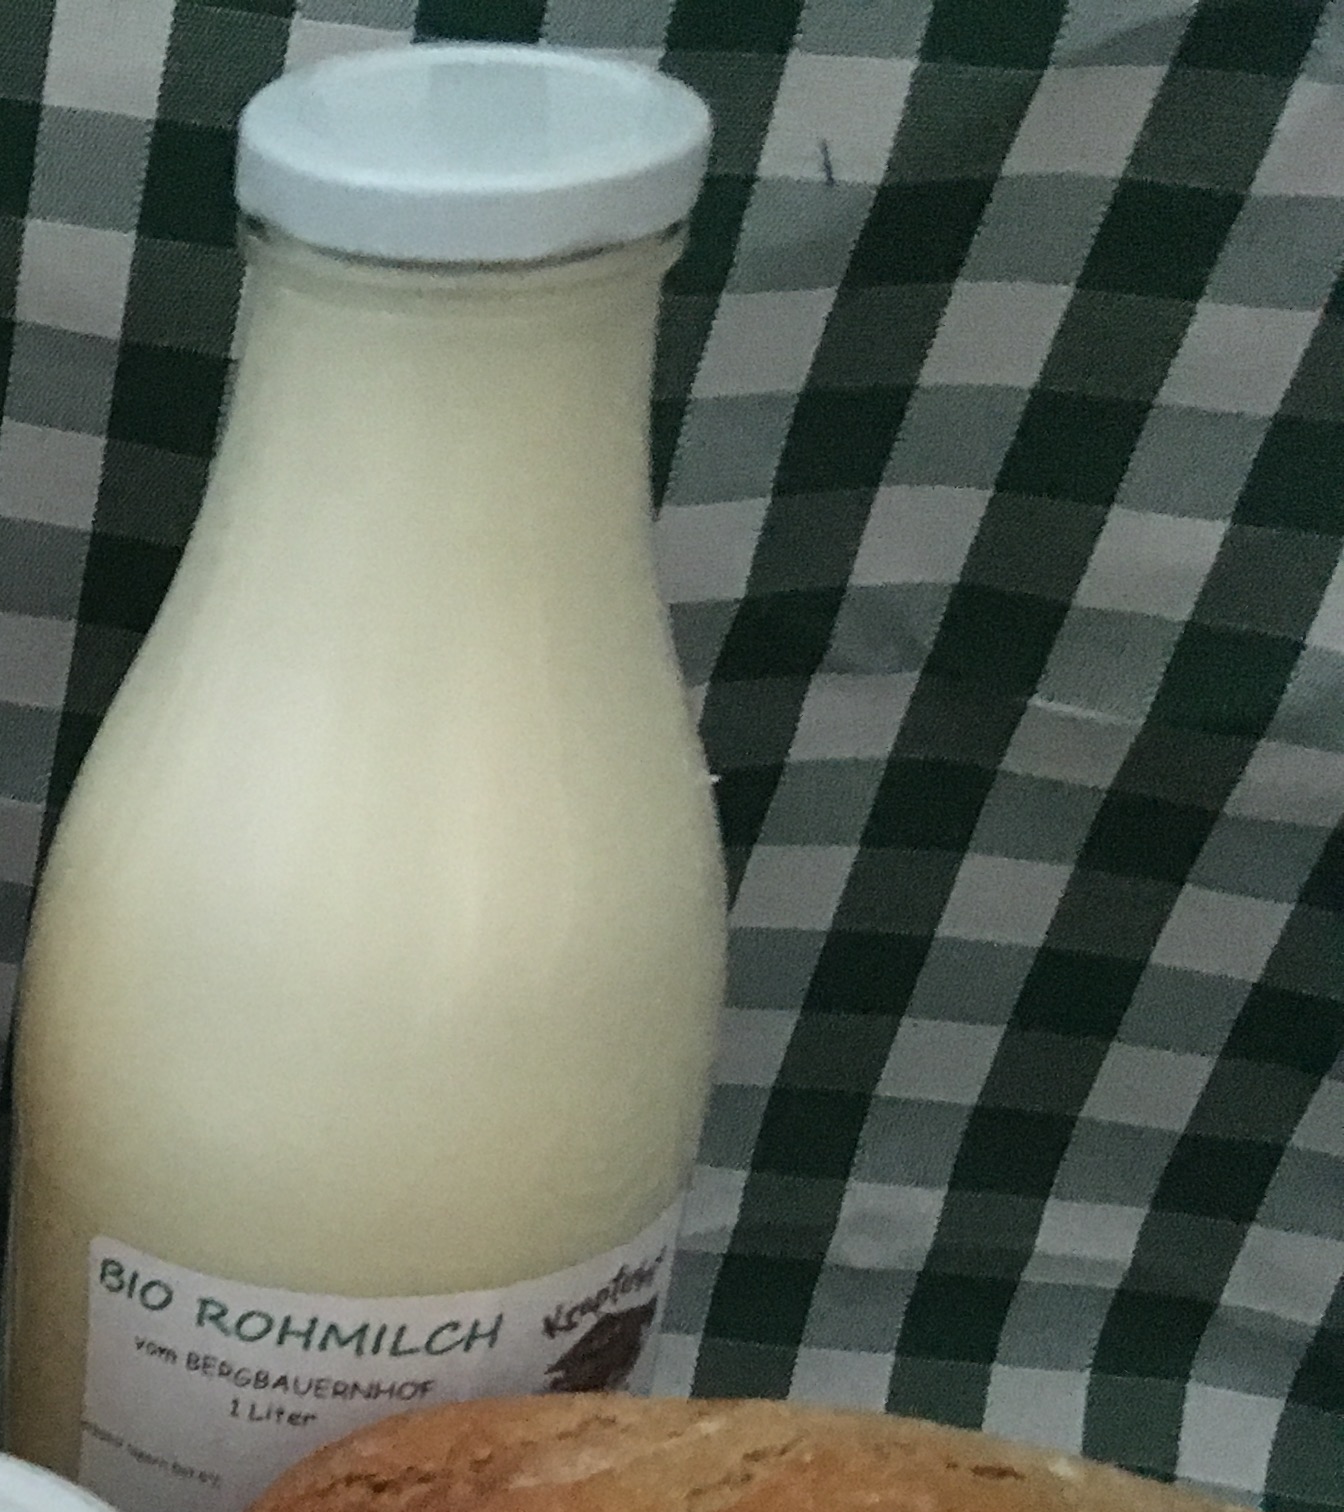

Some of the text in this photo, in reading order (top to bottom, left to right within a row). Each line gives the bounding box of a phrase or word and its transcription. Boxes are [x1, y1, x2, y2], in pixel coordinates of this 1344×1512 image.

[98, 1256, 505, 1358] BIO ROHMILCH
[133, 1335, 438, 1402] vom BERGBAUERNHOF
[247, 1401, 318, 1428] Liter
